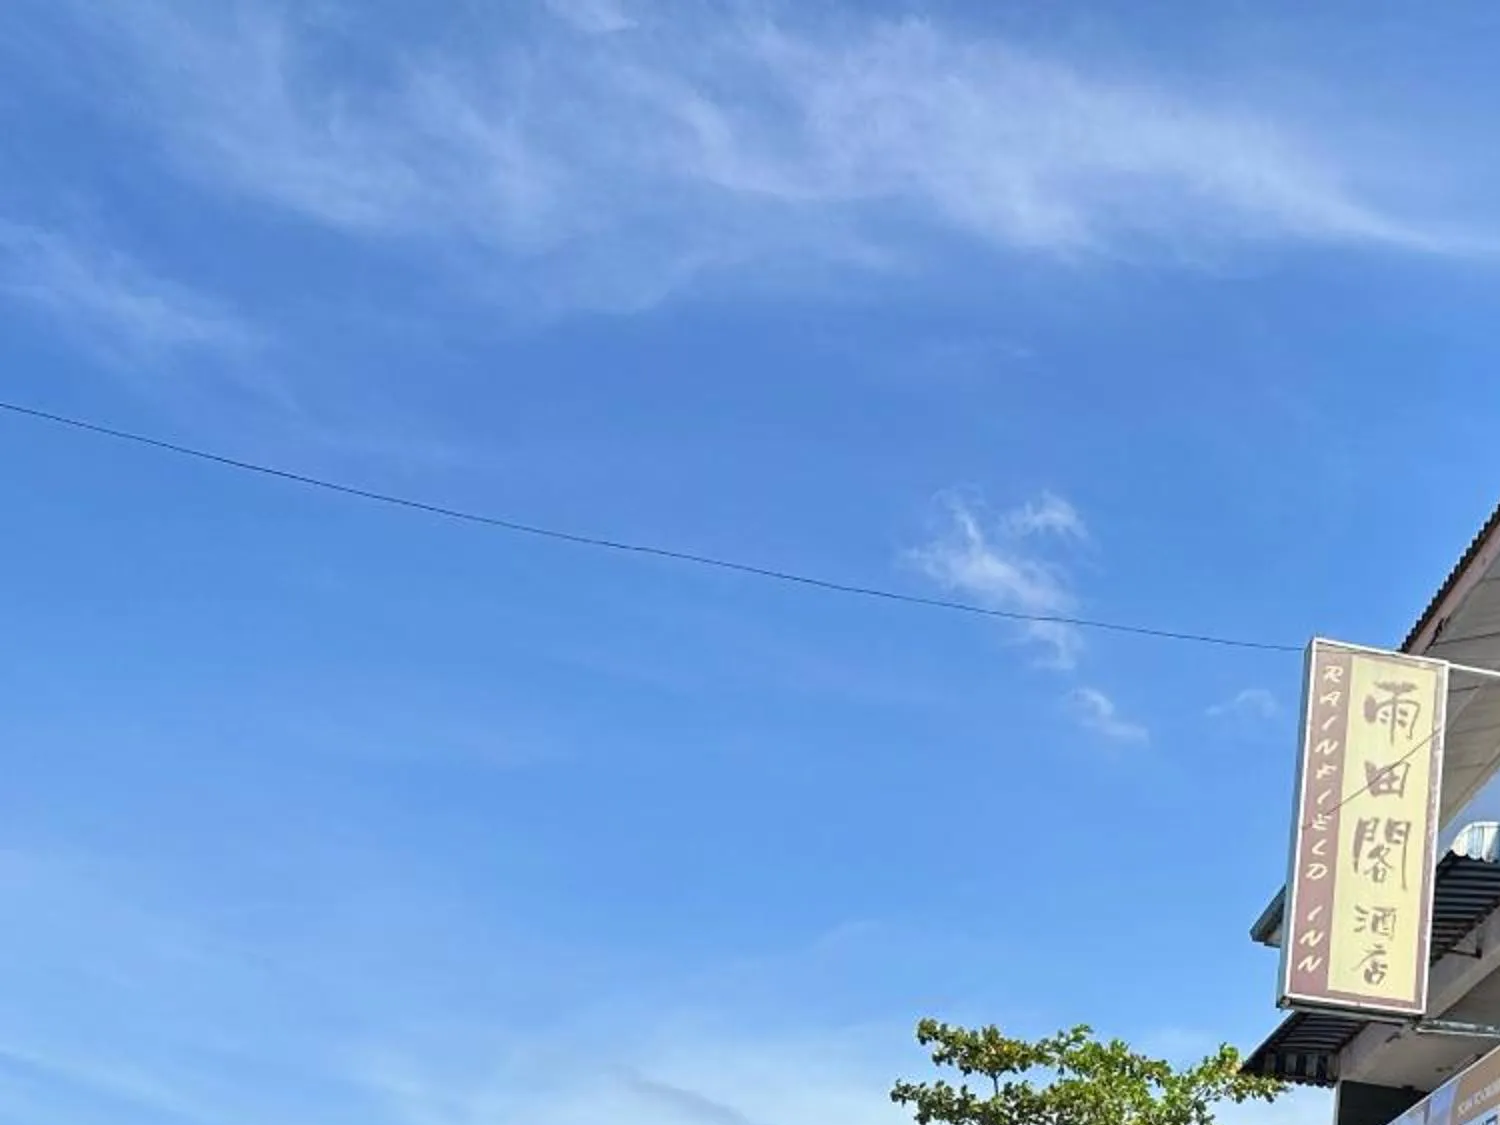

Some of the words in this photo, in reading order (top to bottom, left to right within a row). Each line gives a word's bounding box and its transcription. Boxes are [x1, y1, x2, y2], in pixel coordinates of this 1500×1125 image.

[1306, 664, 1344, 882] RAINFIELD
[1352, 680, 1421, 986] 雨田閣酒店
[1297, 904, 1326, 973] INN
